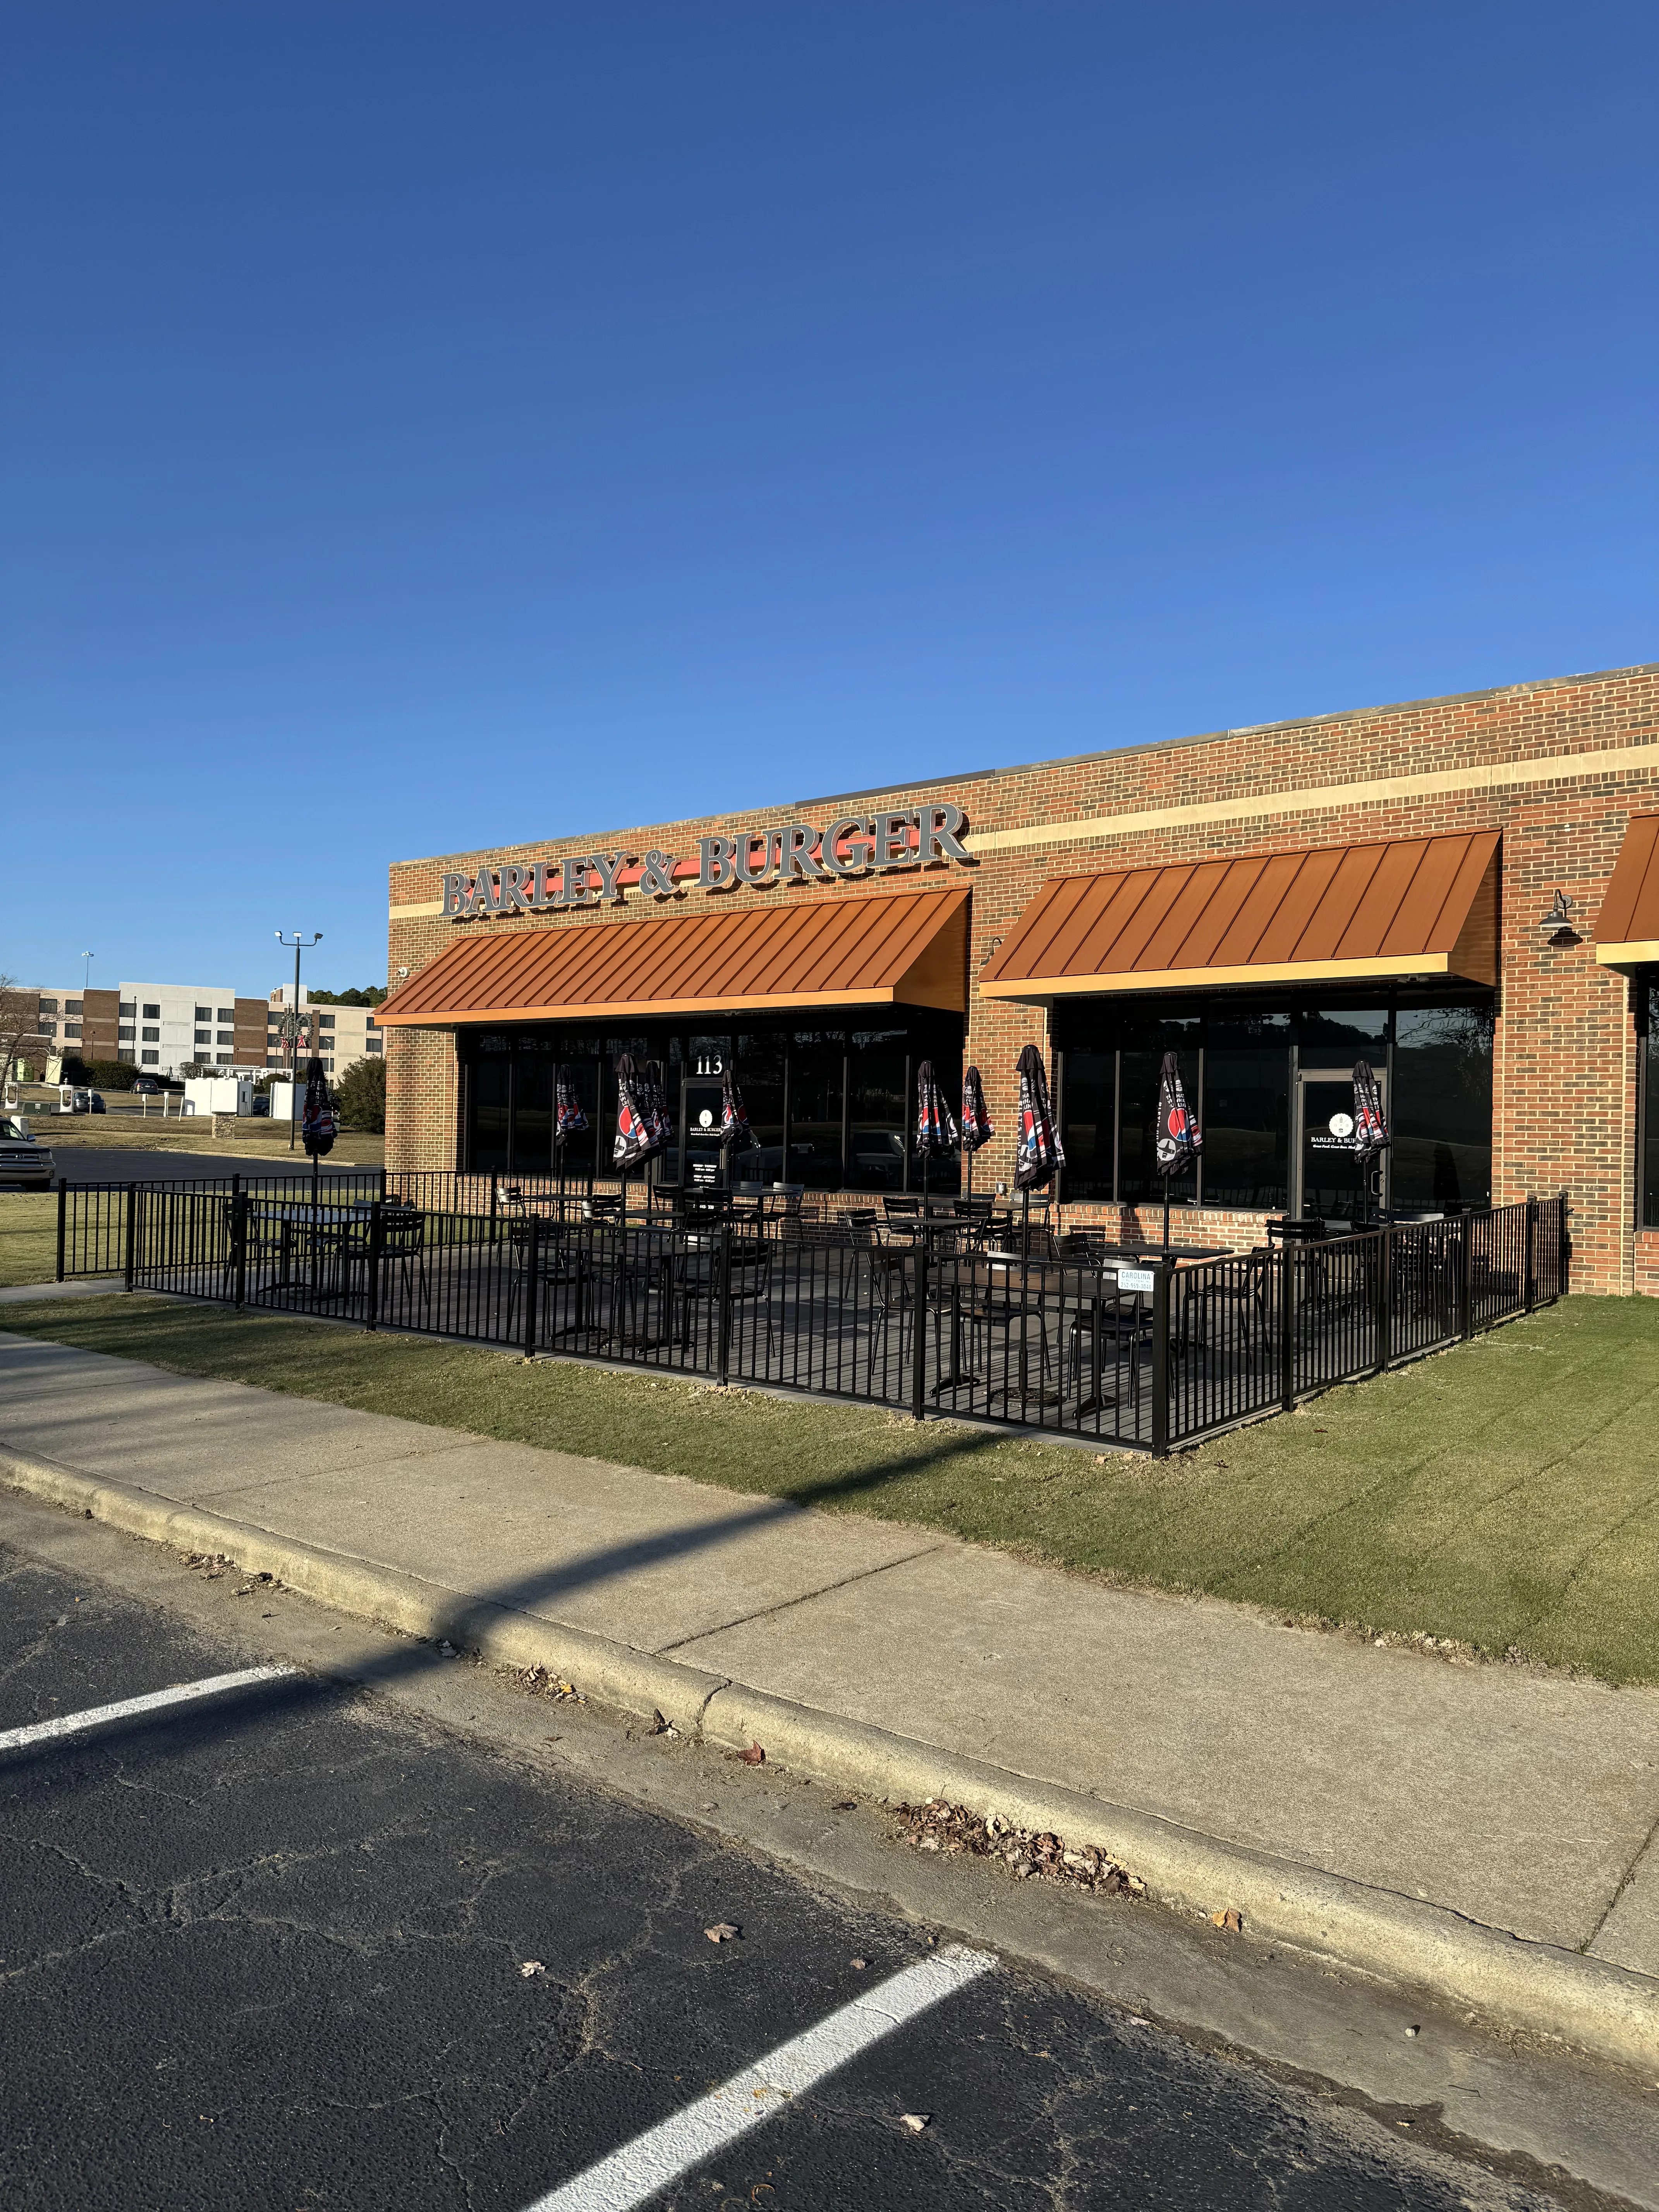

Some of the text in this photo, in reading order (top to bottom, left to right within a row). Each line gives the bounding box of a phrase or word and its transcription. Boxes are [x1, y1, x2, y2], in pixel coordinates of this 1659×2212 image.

[438, 803, 969, 917] BARLEY & BURGER
[696, 1054, 722, 1074] 113
[1121, 1271, 1151, 1280] CAROLINA
